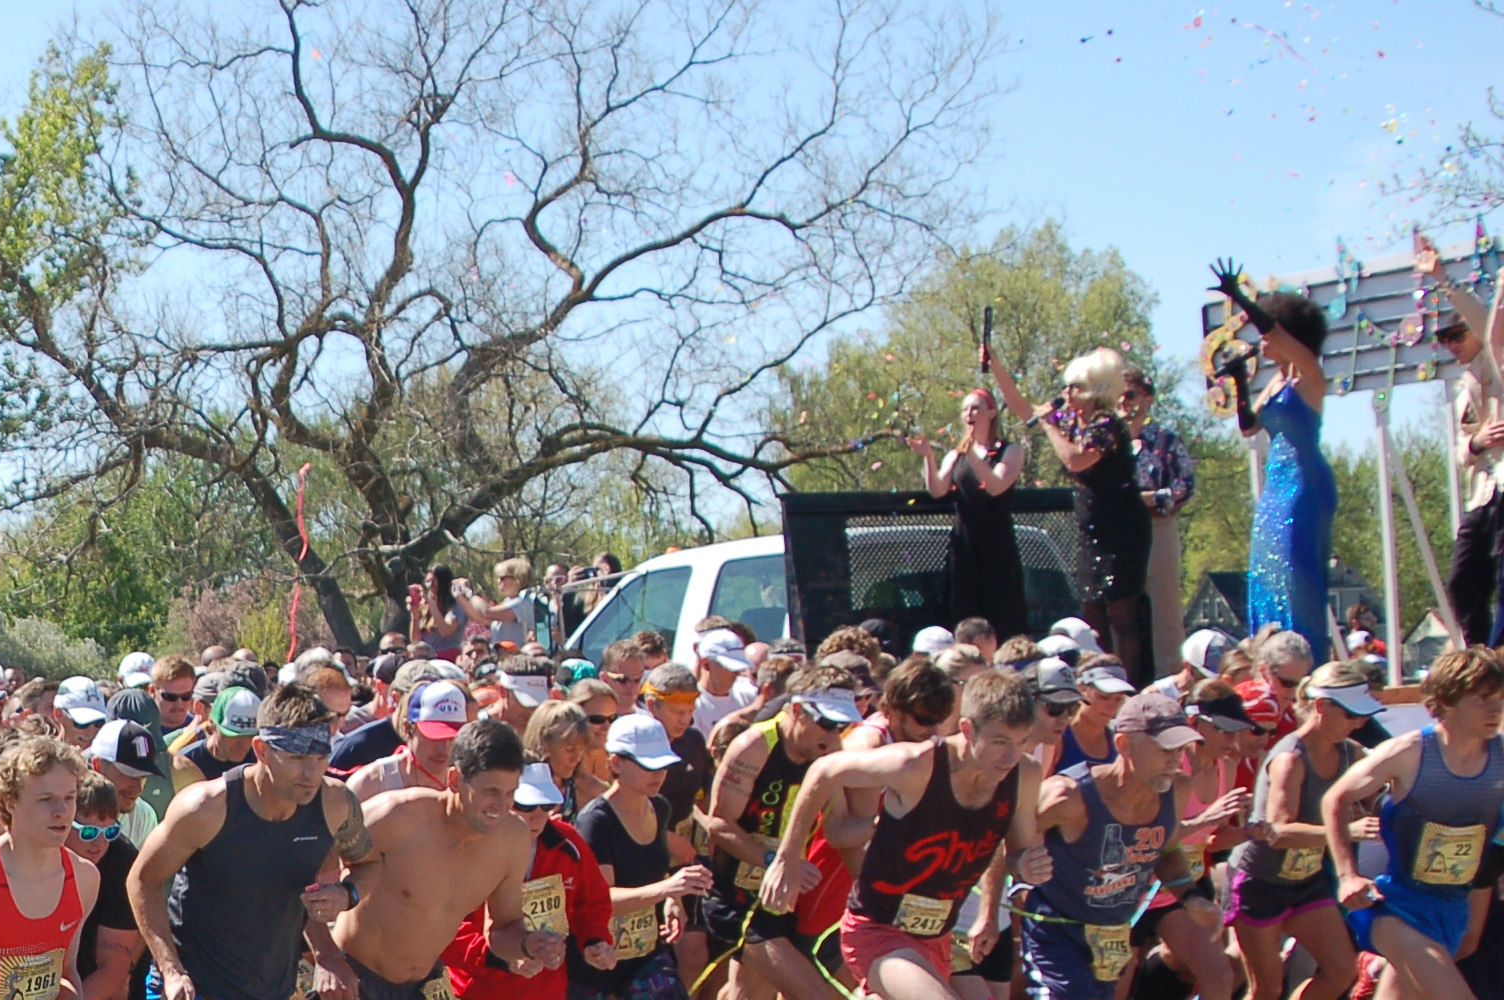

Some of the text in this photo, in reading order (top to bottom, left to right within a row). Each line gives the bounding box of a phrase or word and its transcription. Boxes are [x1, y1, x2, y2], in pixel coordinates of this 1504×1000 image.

[1135, 825, 1165, 850] 20
[1454, 843, 1472, 857] 22
[530, 895, 561, 915] 2180
[910, 916, 946, 931] 2417
[25, 971, 56, 993] 1961
